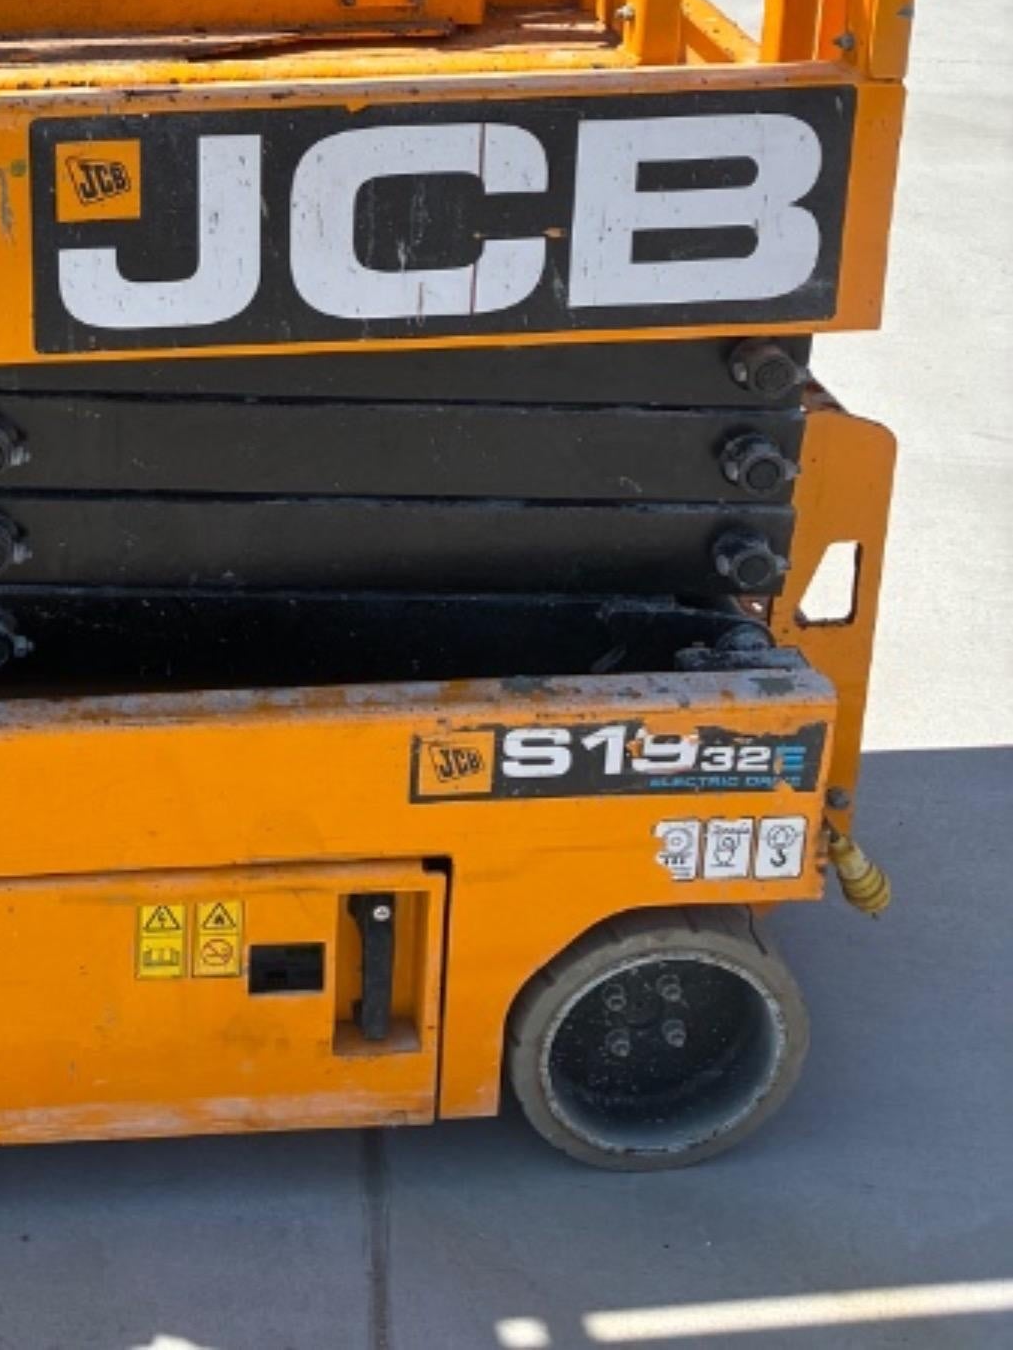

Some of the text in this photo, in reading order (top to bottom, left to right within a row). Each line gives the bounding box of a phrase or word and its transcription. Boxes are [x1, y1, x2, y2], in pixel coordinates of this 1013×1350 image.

[78, 162, 126, 199] JCB
[58, 114, 824, 328] JCB
[649, 776, 738, 788] ELECTRIC
